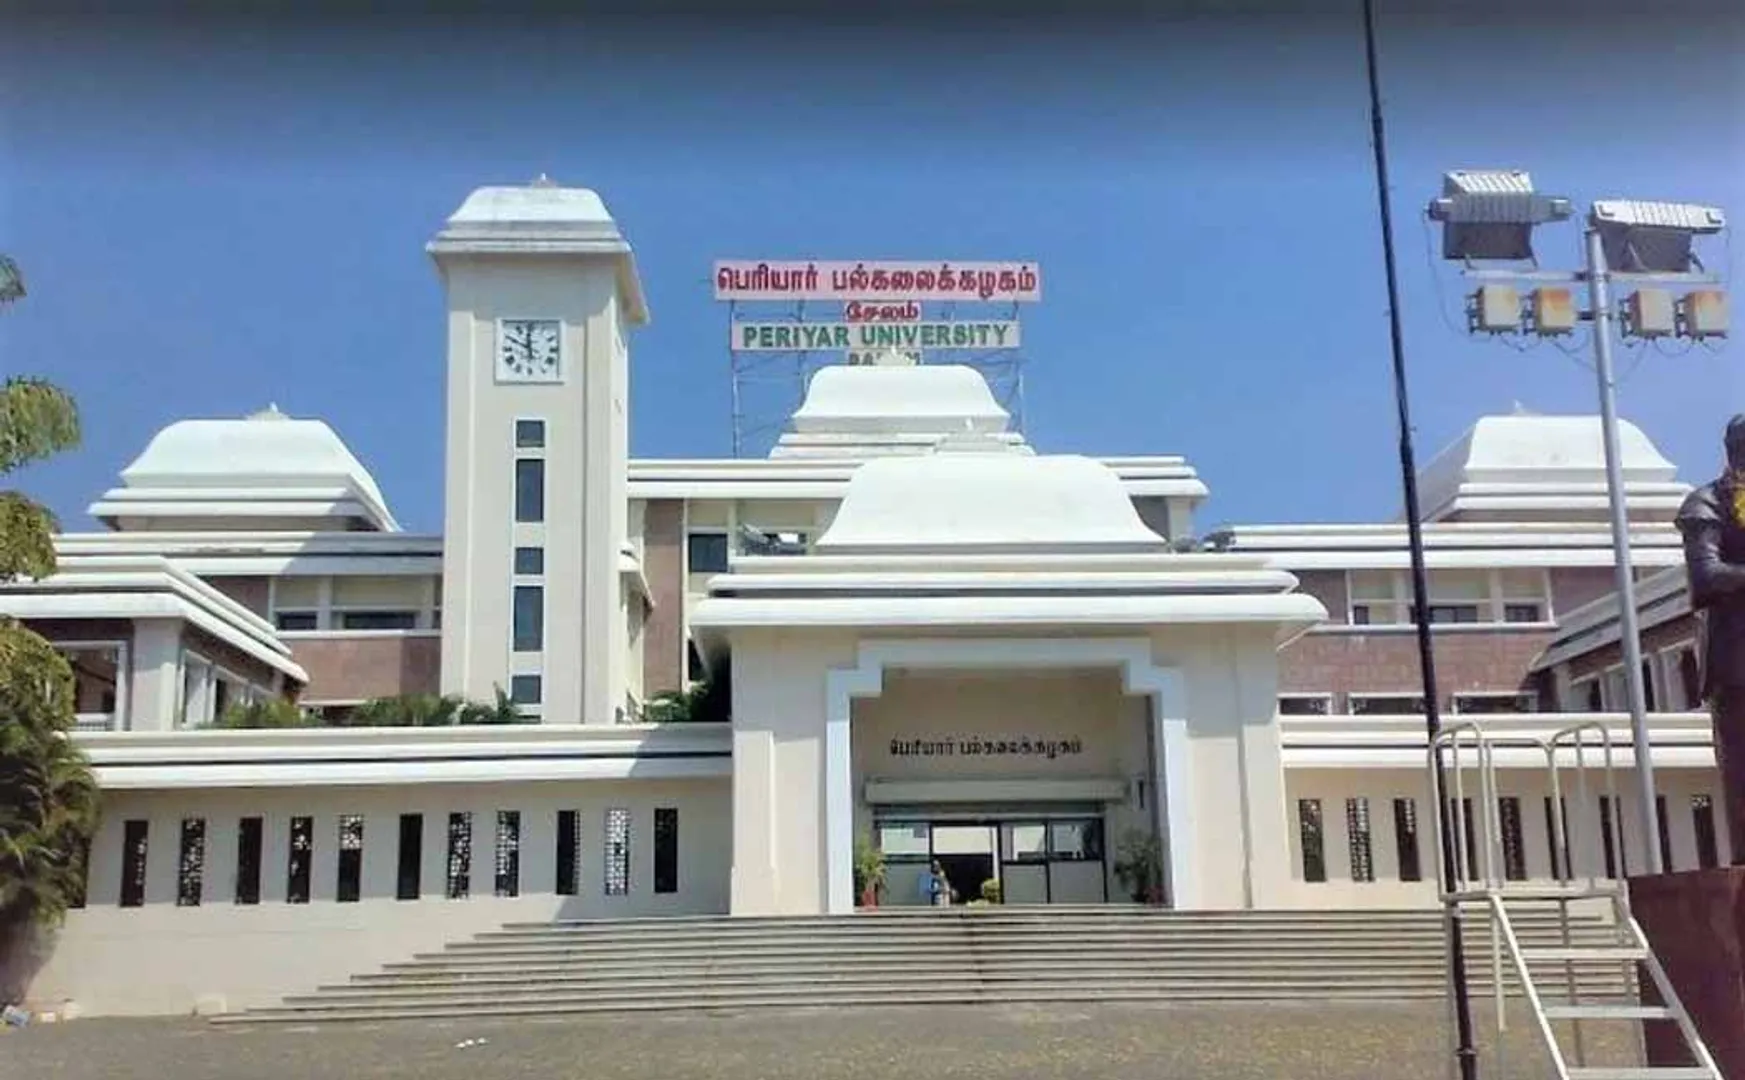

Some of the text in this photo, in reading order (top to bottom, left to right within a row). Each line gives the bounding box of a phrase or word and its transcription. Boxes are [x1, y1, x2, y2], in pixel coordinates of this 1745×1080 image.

[717, 263, 1036, 298] பெரியார் பல்கலைக்கழகம்
[846, 300, 919, 321] சேலம்
[743, 323, 1008, 347] PERIYAR UNIVERSITY
